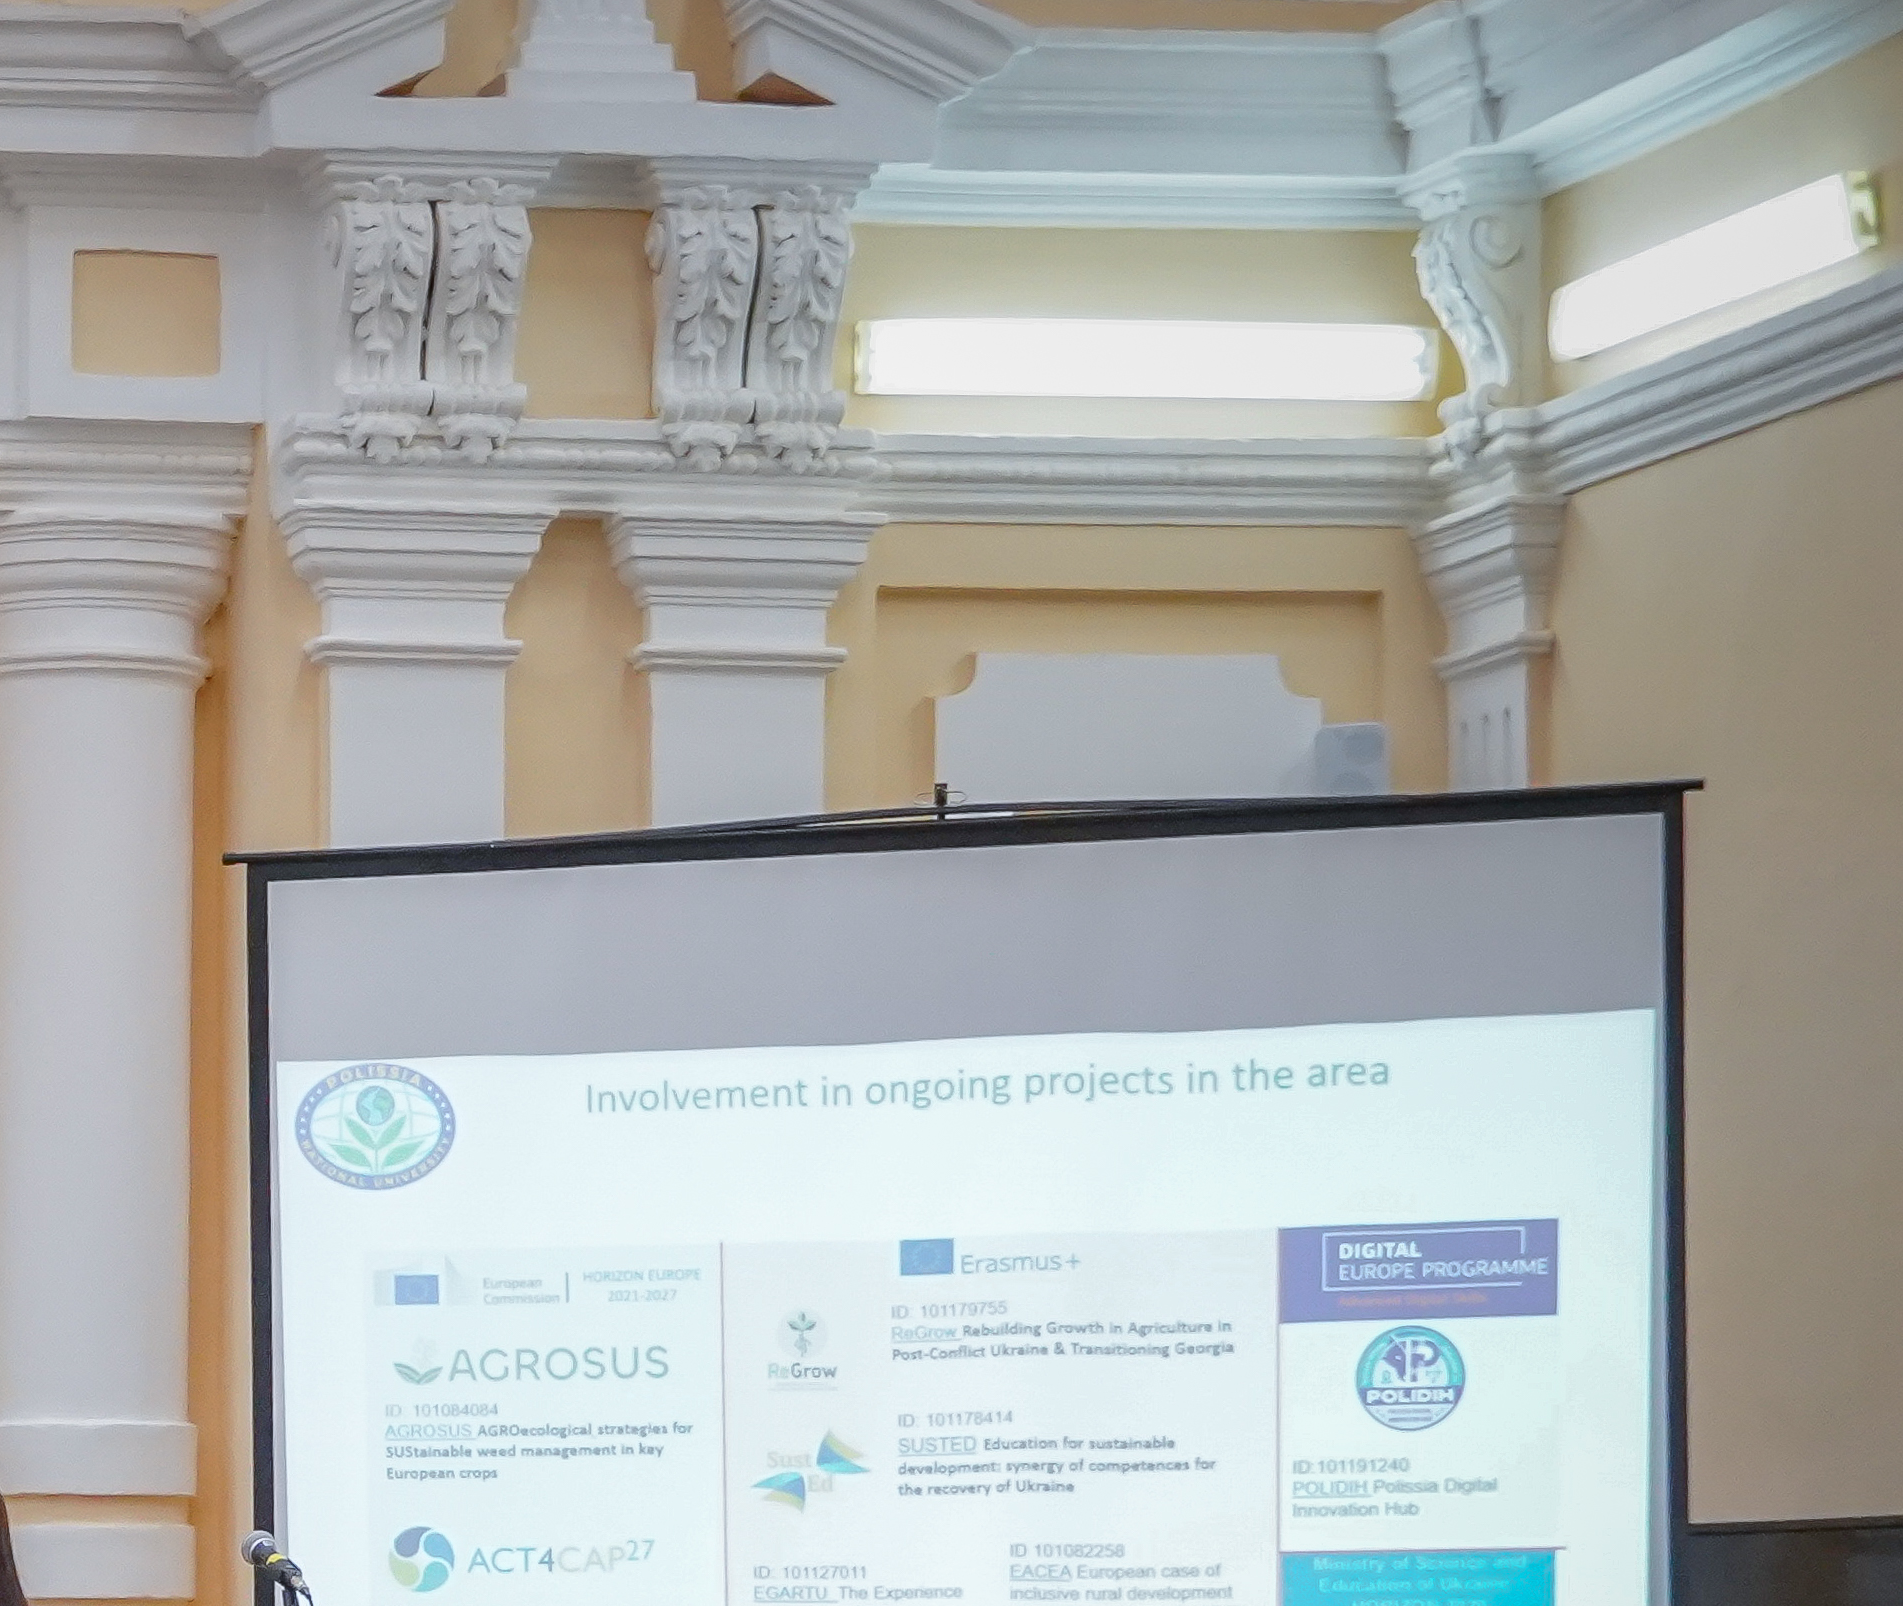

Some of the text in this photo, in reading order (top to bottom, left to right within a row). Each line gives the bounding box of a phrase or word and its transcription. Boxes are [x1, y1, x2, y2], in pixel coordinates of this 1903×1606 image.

[588, 1058, 1389, 1113] Involvement in ongoing projects in the area
[1339, 1241, 1422, 1259] DIGITAL
[961, 1253, 1081, 1274] Erasmus+
[1339, 1257, 1548, 1280] EUROPE PROGRAMME
[648, 1268, 701, 1281] EUROPE
[483, 1278, 542, 1291] European
[891, 1320, 1232, 1340] ReGrow Rebuilding Growth in Agriculture in
[991, 1344, 1048, 1357] Ukraine
[1071, 1342, 1170, 1358] Transitioning
[1175, 1342, 1234, 1356] Georgia
[449, 1345, 669, 1382] AGROSUS
[769, 1363, 837, 1379] ReGrow
[927, 1410, 1012, 1427] 101178414
[385, 1422, 693, 1439] AGROSUS AGROecological strategies for
[386, 1442, 664, 1459] SUStainable weed management in key
[898, 1436, 1175, 1454] SUSTED Education for sustainable
[1006, 1462, 1064, 1474] synergy
[1069, 1458, 1084, 1472] of
[1089, 1461, 1189, 1474] competences
[1194, 1457, 1216, 1470] for
[387, 1468, 497, 1481] European crops
[898, 1479, 1074, 1496] the recovery of Ukraine
[1373, 1479, 1439, 1494] Polissia
[1444, 1477, 1498, 1495] Digital
[1292, 1502, 1420, 1517] Innovation Hub
[1010, 1563, 1222, 1580] EACEA European case of
[754, 1586, 963, 1601] EGARTU The Experience
[1010, 1586, 1233, 1603] inclusive rural development
